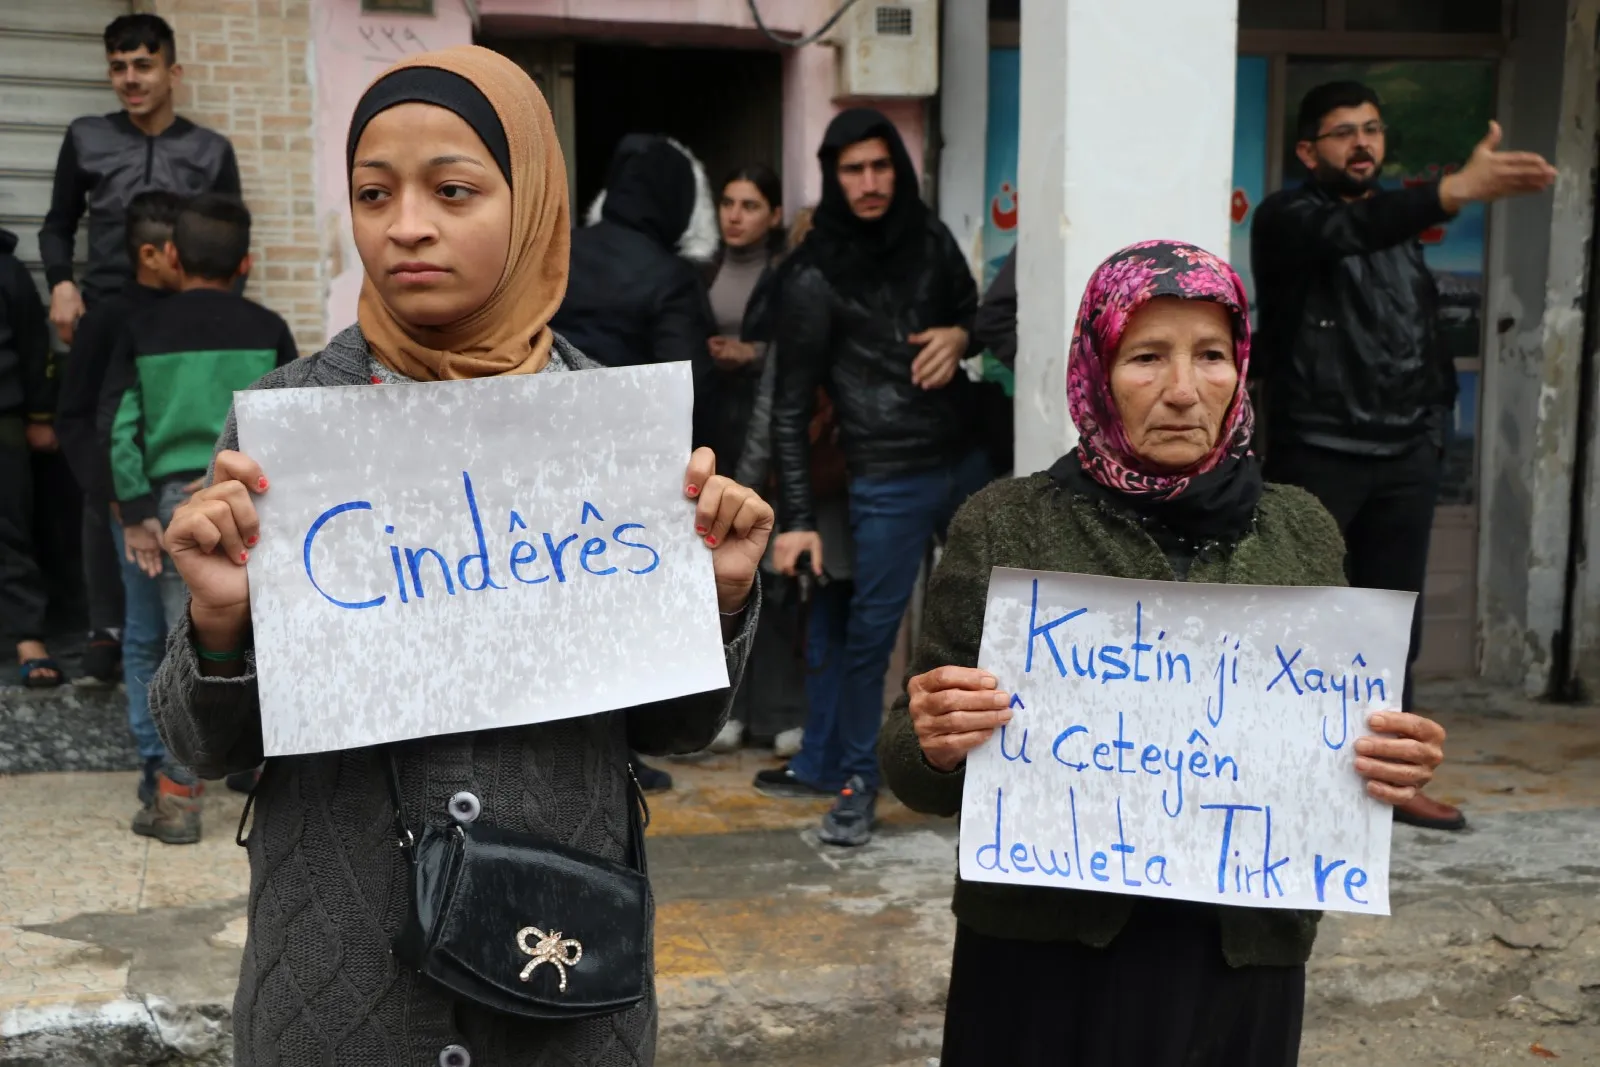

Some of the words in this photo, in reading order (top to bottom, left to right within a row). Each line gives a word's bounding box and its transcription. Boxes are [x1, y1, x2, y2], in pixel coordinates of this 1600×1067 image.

[304, 471, 660, 609] Cindêrês
[1207, 636, 1240, 728] ji
[976, 787, 1172, 888] dewleta
[1200, 804, 1290, 899] Tirk
[1313, 855, 1369, 905] re
